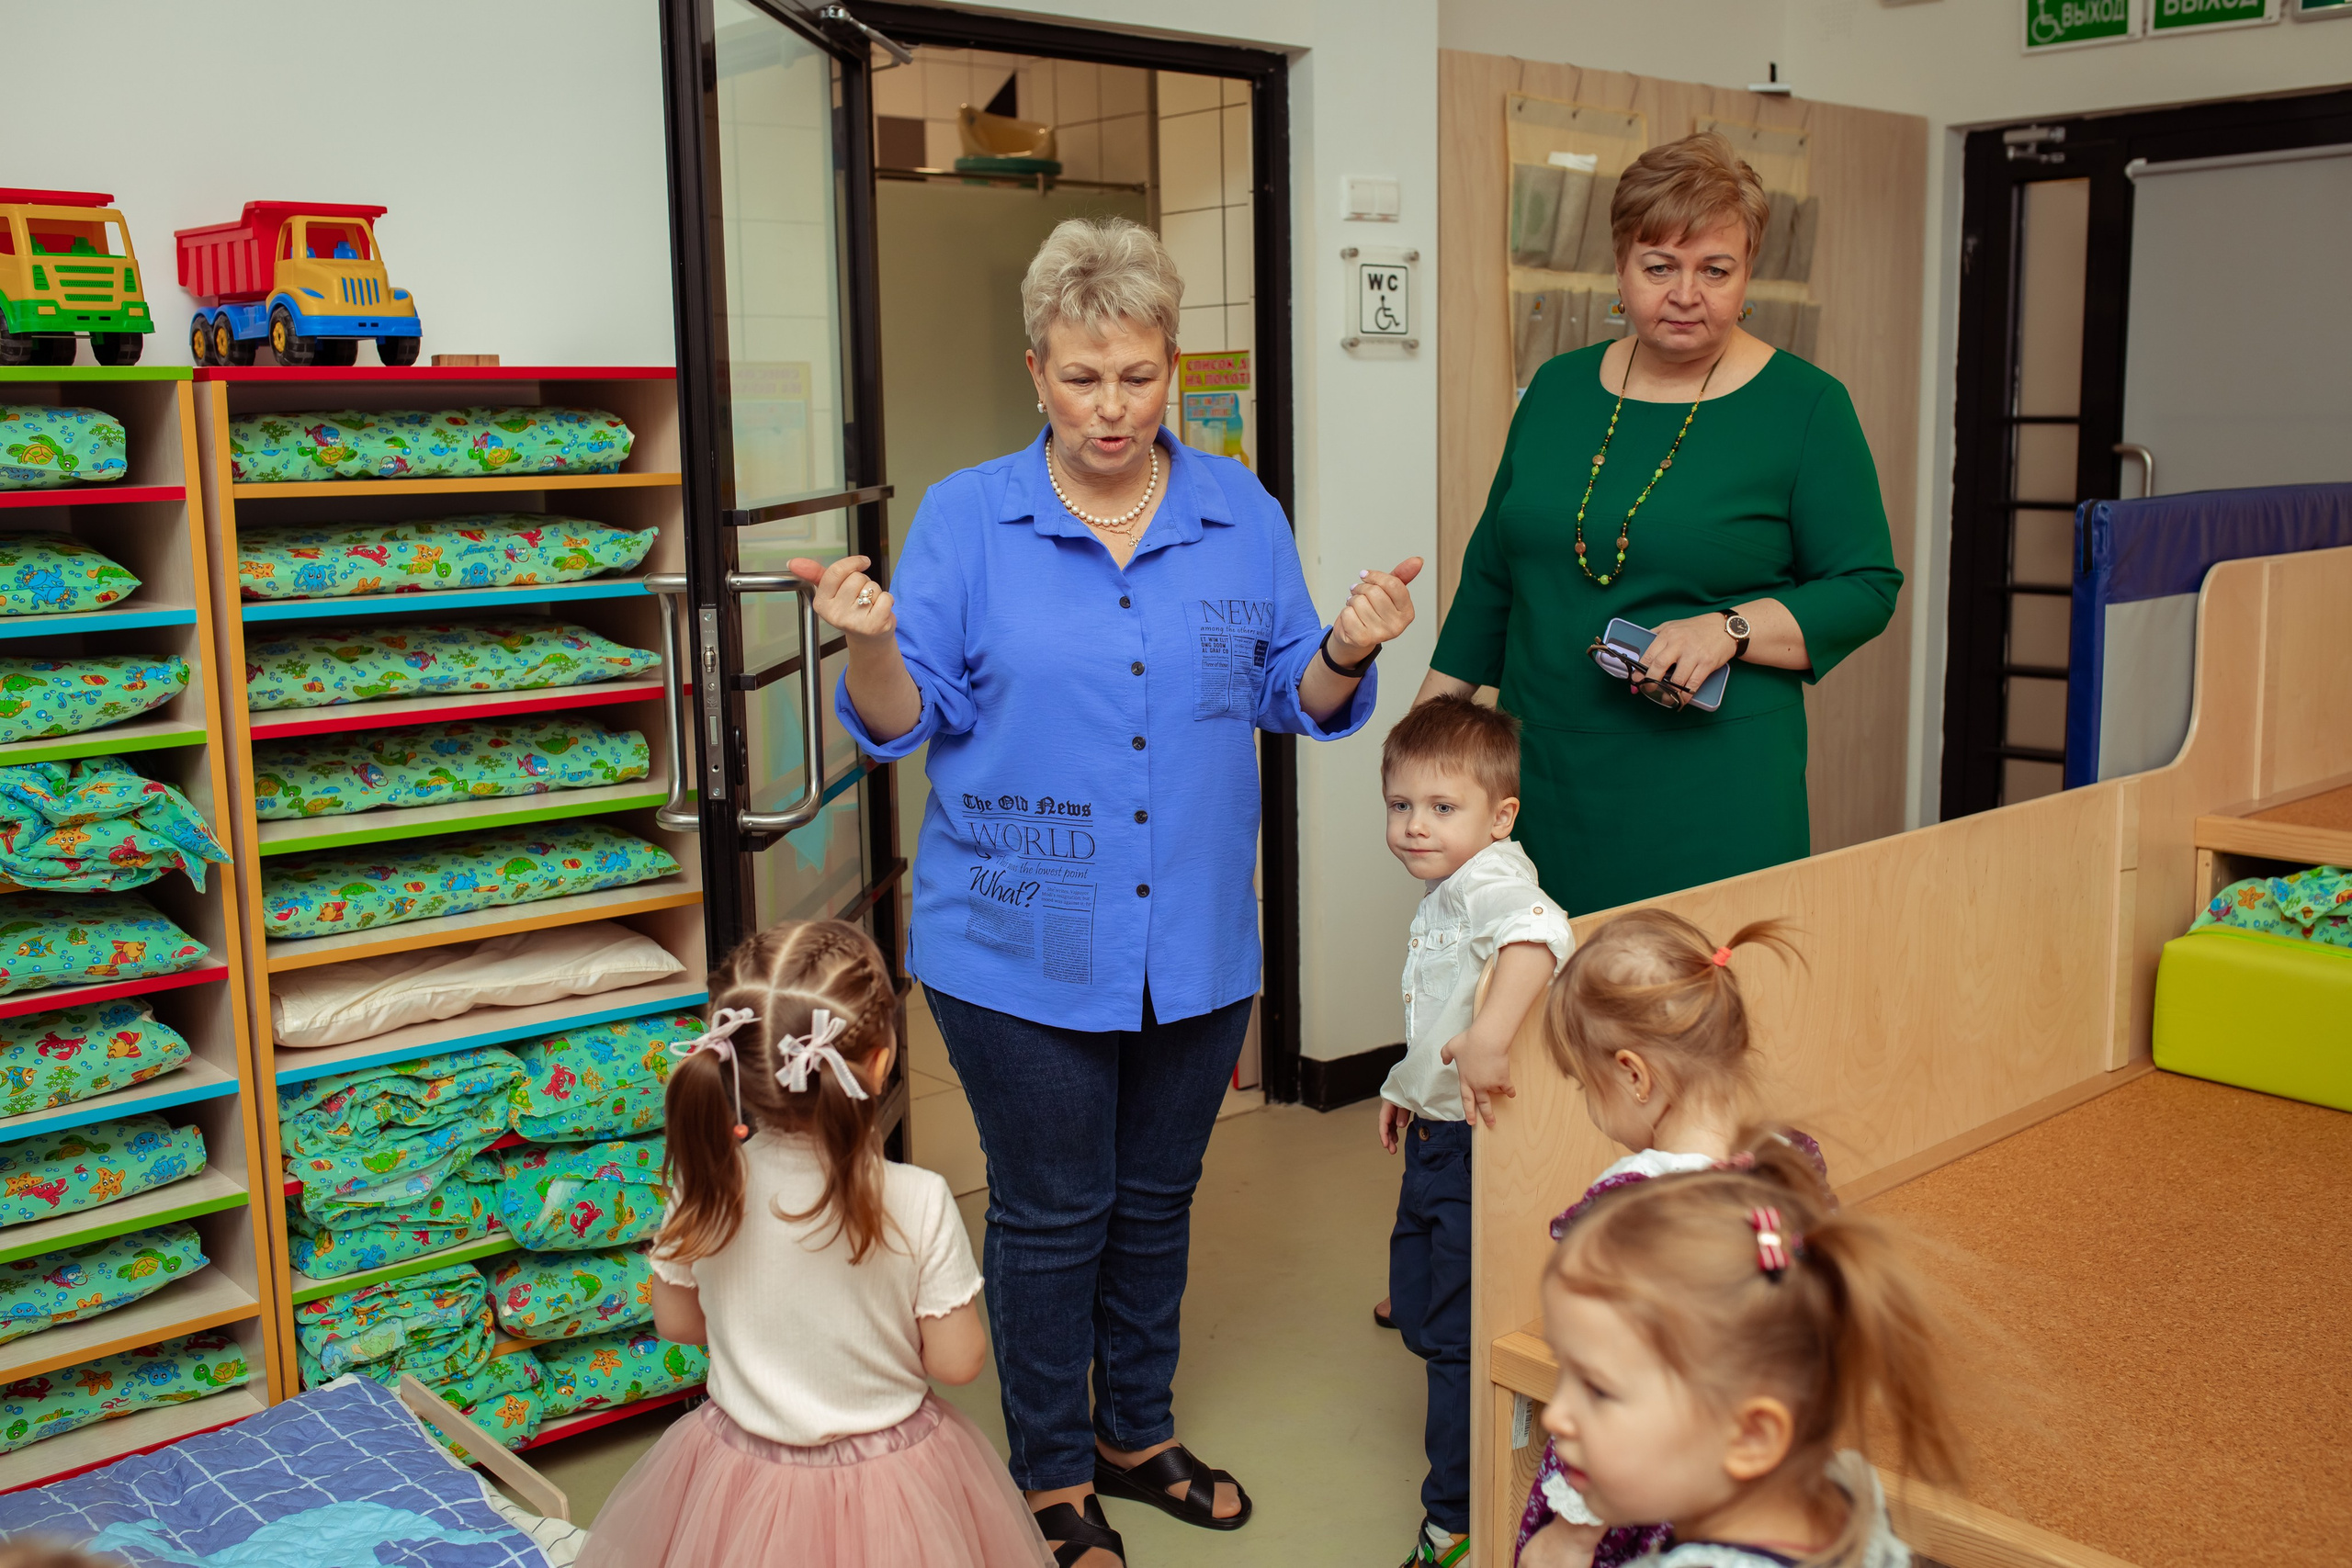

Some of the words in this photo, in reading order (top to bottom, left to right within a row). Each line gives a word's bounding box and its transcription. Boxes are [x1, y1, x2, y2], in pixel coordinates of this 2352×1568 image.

[2061, 0, 2125, 28] ВЫХОД
[1367, 273, 1398, 291] WC
[1198, 599, 1273, 627] NEWS
[1200, 626, 1224, 635] among
[1238, 626, 1255, 635] others
[962, 793, 992, 813] The
[998, 795, 1028, 812] Old
[1035, 796, 1091, 817] News
[967, 822, 1095, 860] WORLD
[1020, 862, 1034, 874] the
[1035, 862, 1062, 876] lowest
[1062, 868, 1089, 882] point
[969, 865, 1041, 908] What?
